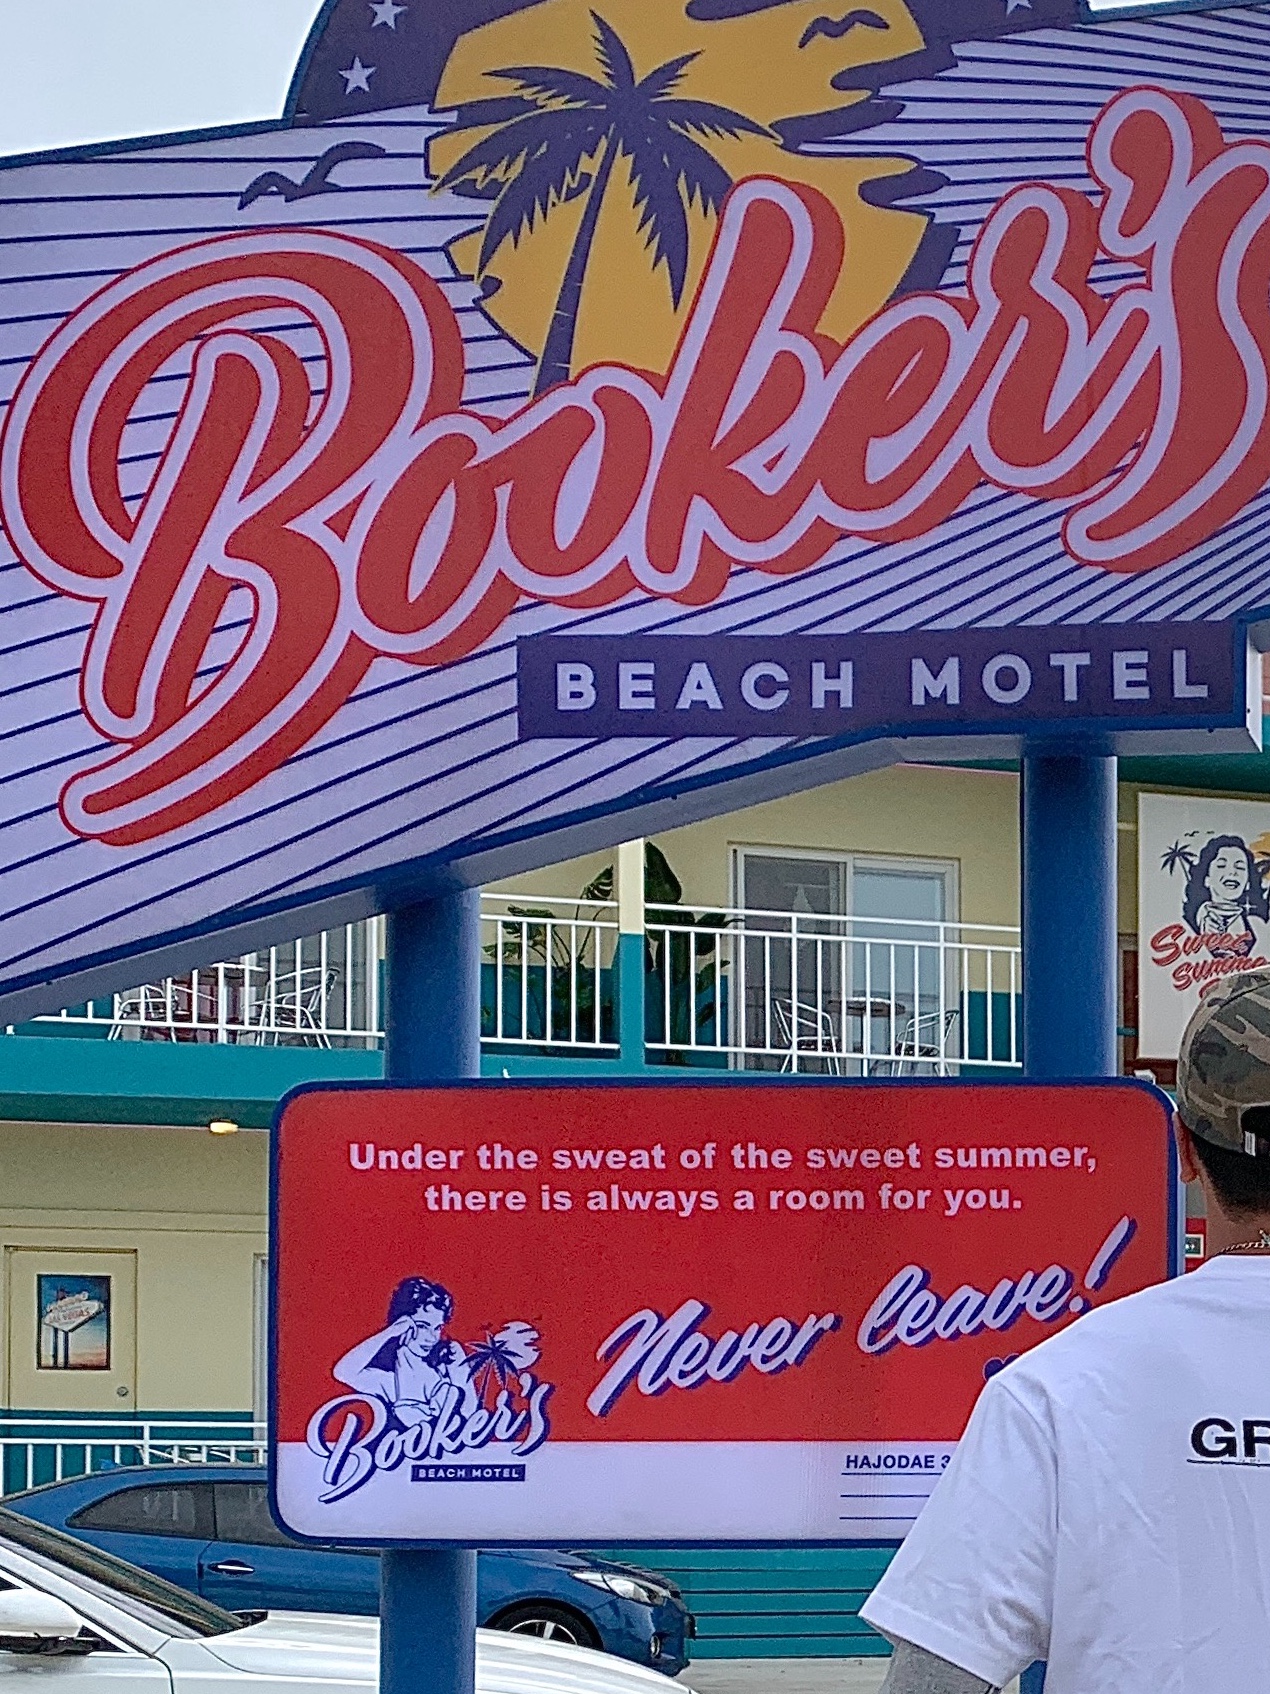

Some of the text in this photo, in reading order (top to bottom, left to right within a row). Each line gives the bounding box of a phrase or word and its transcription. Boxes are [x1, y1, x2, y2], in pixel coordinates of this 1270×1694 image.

[555, 650, 1208, 711] BEACH MOTEL
[349, 1142, 1098, 1173] Under the sweat of the sweet summer,
[424, 1183, 1023, 1217] there is always a room for you.
[586, 1215, 1138, 1418] Never leave!
[306, 1370, 556, 1505] Booker's
[417, 1467, 520, 1479] BEACH MOTEL
[845, 1454, 935, 1469] HAJODAE
